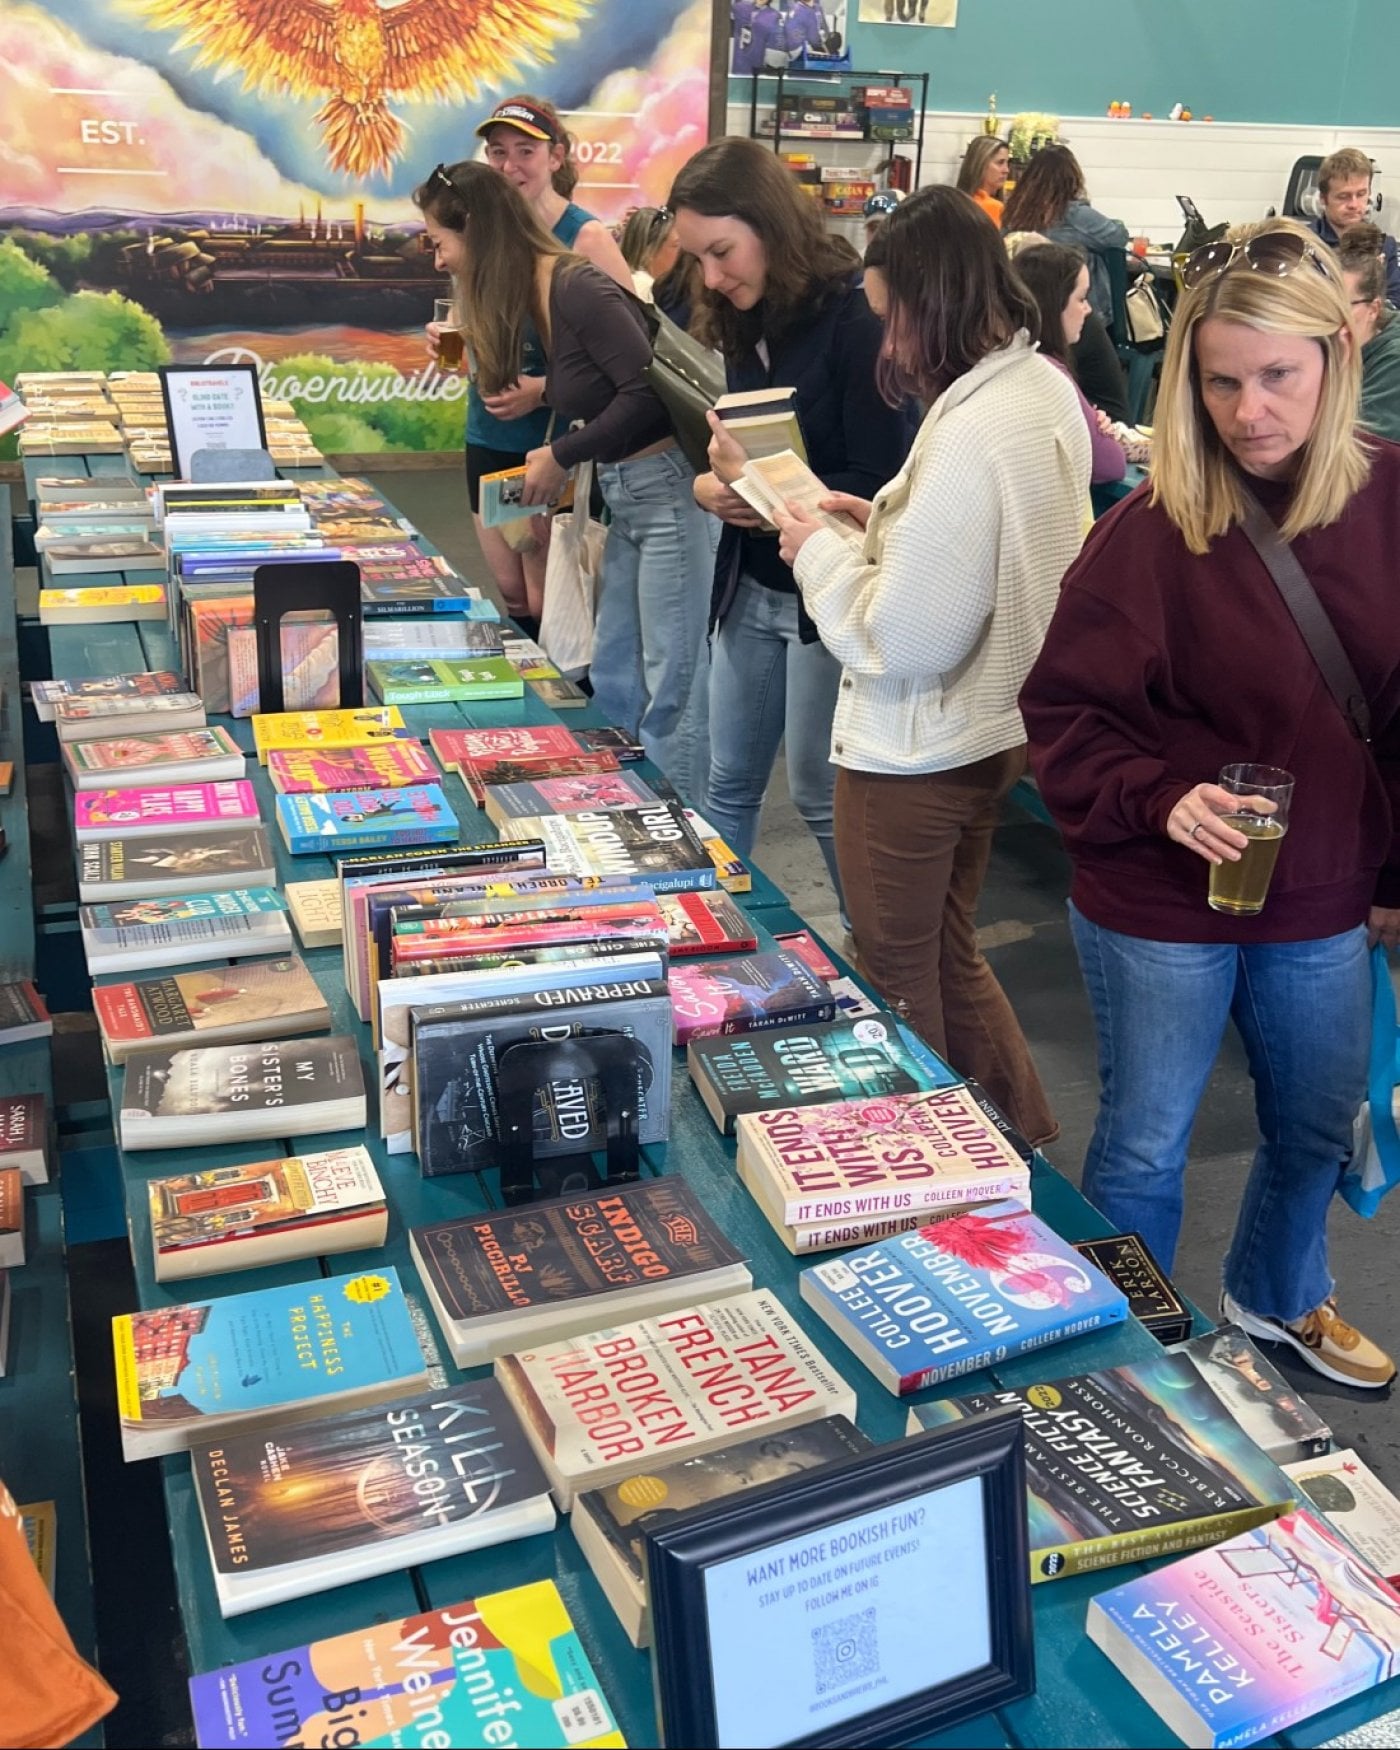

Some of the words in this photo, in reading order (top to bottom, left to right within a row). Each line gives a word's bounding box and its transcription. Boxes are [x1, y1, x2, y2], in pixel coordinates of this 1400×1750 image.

[81, 119, 146, 146] EST.
[570, 141, 623, 164] 022
[388, 691, 423, 702] Tough
[173, 790, 206, 813] HAPPY
[637, 805, 683, 842] GIRL
[349, 852, 403, 863] HARLAN
[404, 848, 449, 859] COBEN
[576, 812, 639, 875] WINDUP
[146, 985, 172, 1026] ATWOOD
[160, 978, 190, 1028] MARGARET
[534, 980, 652, 1006] DEPRAVED
[748, 1018, 775, 1029] TARAH
[229, 1054, 250, 1103] BONES
[261, 1044, 284, 1107] SISTER'S
[296, 1060, 316, 1082] MY
[712, 1053, 752, 1092] FREIDA
[773, 1036, 846, 1095] WARD
[9, 1105, 26, 1132] SARAH
[758, 1110, 826, 1166] ENDS
[927, 1091, 1010, 1171] HOOVER
[791, 1171, 841, 1192] IT
[818, 1127, 887, 1188] WITH
[882, 1148, 935, 1181] US
[665, 1211, 699, 1244] THE
[798, 1206, 812, 1220] IT
[815, 1199, 851, 1219] ENDS
[856, 1195, 890, 1213] WITH
[892, 1193, 912, 1209] US
[924, 1189, 964, 1203] COLLEEN
[965, 1184, 1002, 1200] HOOVER
[564, 1203, 640, 1284] SCARF
[597, 1196, 671, 1278] INDIGO
[808, 1231, 822, 1247] IT
[824, 1226, 860, 1245] ENDS
[862, 1219, 897, 1238] WITH
[900, 1216, 919, 1231] US
[472, 1222, 531, 1307] PICCIRILLO
[508, 1253, 534, 1274] PJ
[900, 1235, 1020, 1336] NOVEMBER
[989, 1252, 1092, 1310] 9
[1109, 1260, 1144, 1300] ERIK
[1119, 1244, 1171, 1312] LARSON
[342, 1321, 353, 1338] THE
[838, 1282, 911, 1349] COLLEE
[848, 1250, 970, 1356] HOOVER
[289, 1307, 318, 1370] PROJECT
[309, 1294, 344, 1376] HAPPINESS
[758, 1300, 775, 1316] NEW
[771, 1316, 790, 1335] YORK
[786, 1335, 810, 1359] TIMES
[805, 1360, 839, 1395] Bestseller
[920, 1353, 991, 1388] NOVEMBER
[995, 1344, 1008, 1365] 9
[1020, 1327, 1064, 1351] COLLEEN
[1064, 1315, 1101, 1338] HOOVER
[594, 1337, 696, 1446] BROKEN
[659, 1314, 761, 1428] FRENCH
[734, 1334, 816, 1413] TANA
[1035, 1386, 1056, 1408] 2022
[546, 1349, 647, 1462] HARBOR
[1066, 1381, 1155, 1451] ROANHORSE
[265, 1441, 282, 1481] CASHEN
[276, 1446, 291, 1471] JAKE
[386, 1408, 457, 1518] SEASON
[430, 1394, 516, 1504] KILL
[1047, 1409, 1166, 1489] FANTASY
[208, 1449, 236, 1507] DECLAN
[222, 1515, 249, 1564] JAMES
[1048, 1466, 1087, 1495] BEST
[1067, 1452, 1161, 1519] SCIENCE
[1159, 1452, 1227, 1508] REBECCA
[1090, 1497, 1122, 1526] THE
[746, 1557, 786, 1587] WANT
[789, 1543, 827, 1572] MORE
[830, 1520, 889, 1558] BOOKISH
[891, 1507, 926, 1535] FUN?
[759, 1589, 781, 1608] STAY
[783, 1585, 795, 1599] UP
[797, 1580, 809, 1593] TO
[810, 1572, 832, 1589] DATE
[834, 1564, 848, 1580] ON
[849, 1552, 883, 1574] FUTURE
[884, 1538, 921, 1562] EVENTS!
[1077, 1549, 1120, 1571] SCIENCE
[1120, 1543, 1160, 1564] FICTION
[1160, 1539, 1183, 1557] AND
[1184, 1529, 1228, 1553] FANTASY
[805, 1591, 840, 1612] FOLLOW
[841, 1584, 853, 1600] ME
[854, 1578, 869, 1594] ON
[870, 1575, 880, 1588] IG
[1193, 1571, 1265, 1637] Seaside
[1238, 1581, 1306, 1645] Sisters
[1132, 1602, 1234, 1705] PAMELA
[1156, 1600, 1256, 1690] KELLEY
[1266, 1640, 1305, 1679] The
[389, 1626, 452, 1749] Weine
[1217, 1722, 1268, 1750] PAMELA
